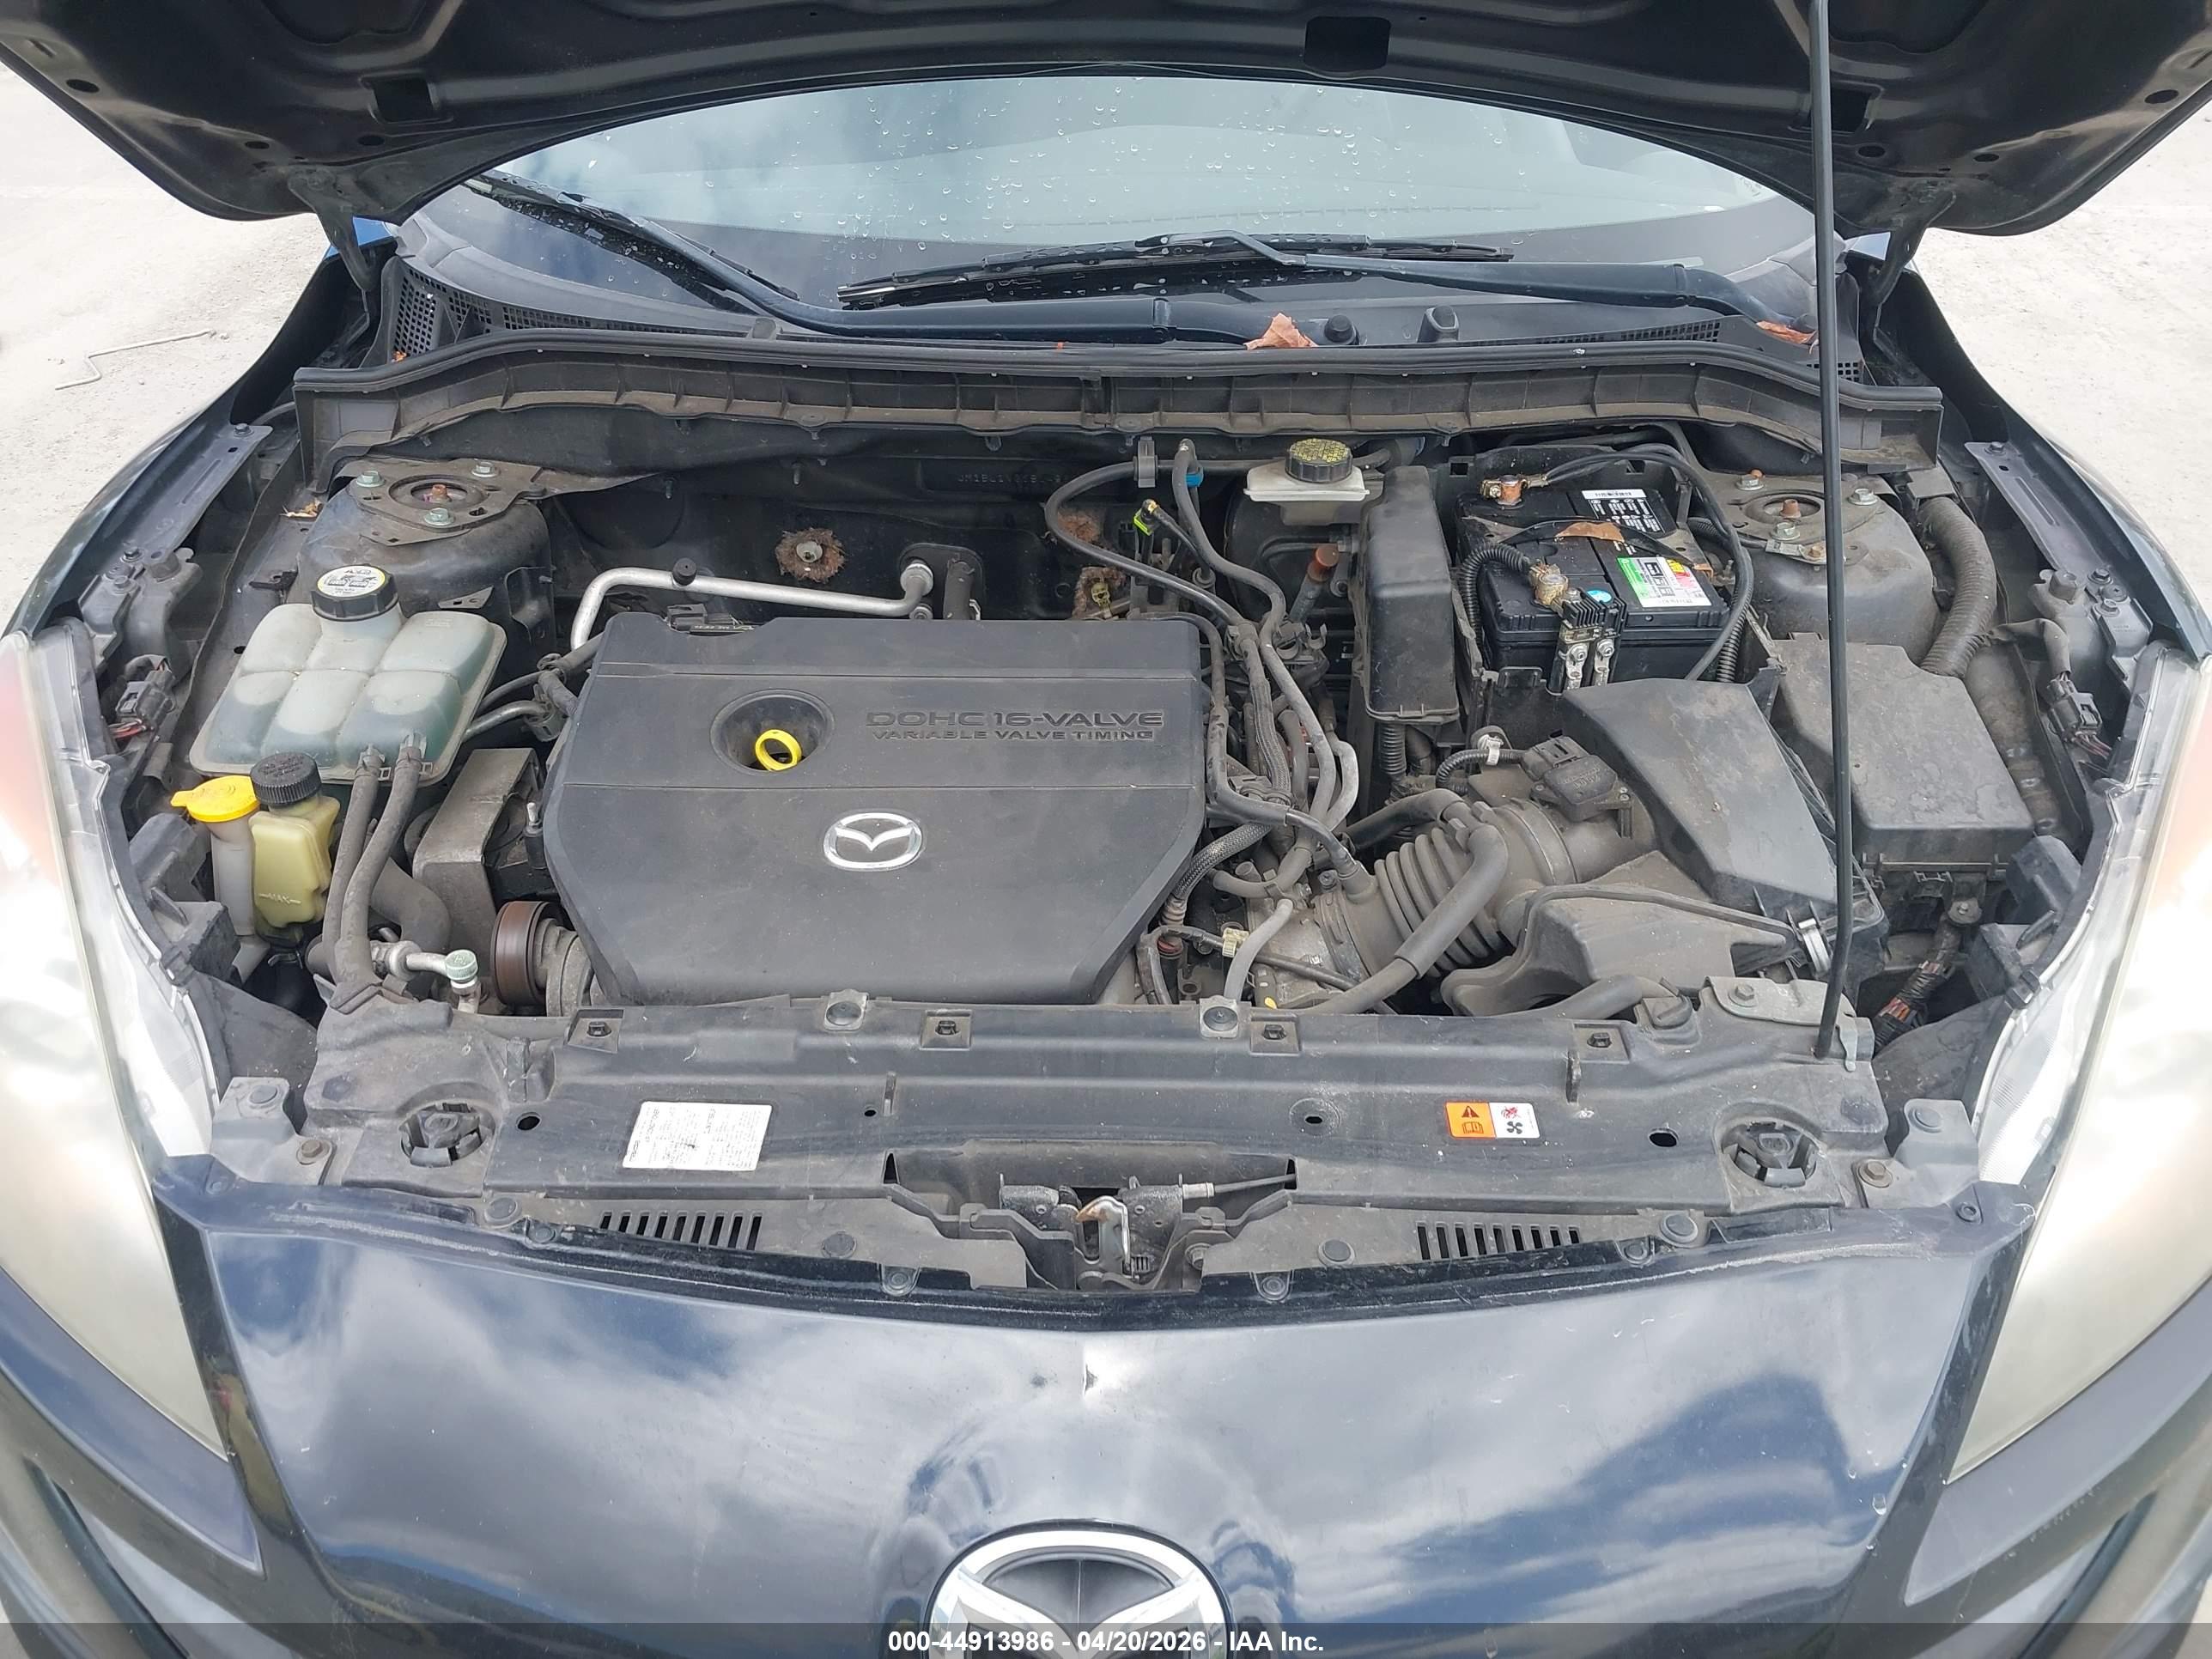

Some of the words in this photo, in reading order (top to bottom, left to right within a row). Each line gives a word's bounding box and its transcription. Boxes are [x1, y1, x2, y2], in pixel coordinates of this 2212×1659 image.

[866, 712, 985, 726] DOHC
[994, 712, 1163, 726] 16-VALVE
[872, 731, 988, 740] VARIABLE
[994, 730, 1066, 740] VALVE
[1073, 731, 1153, 740] TIMING
